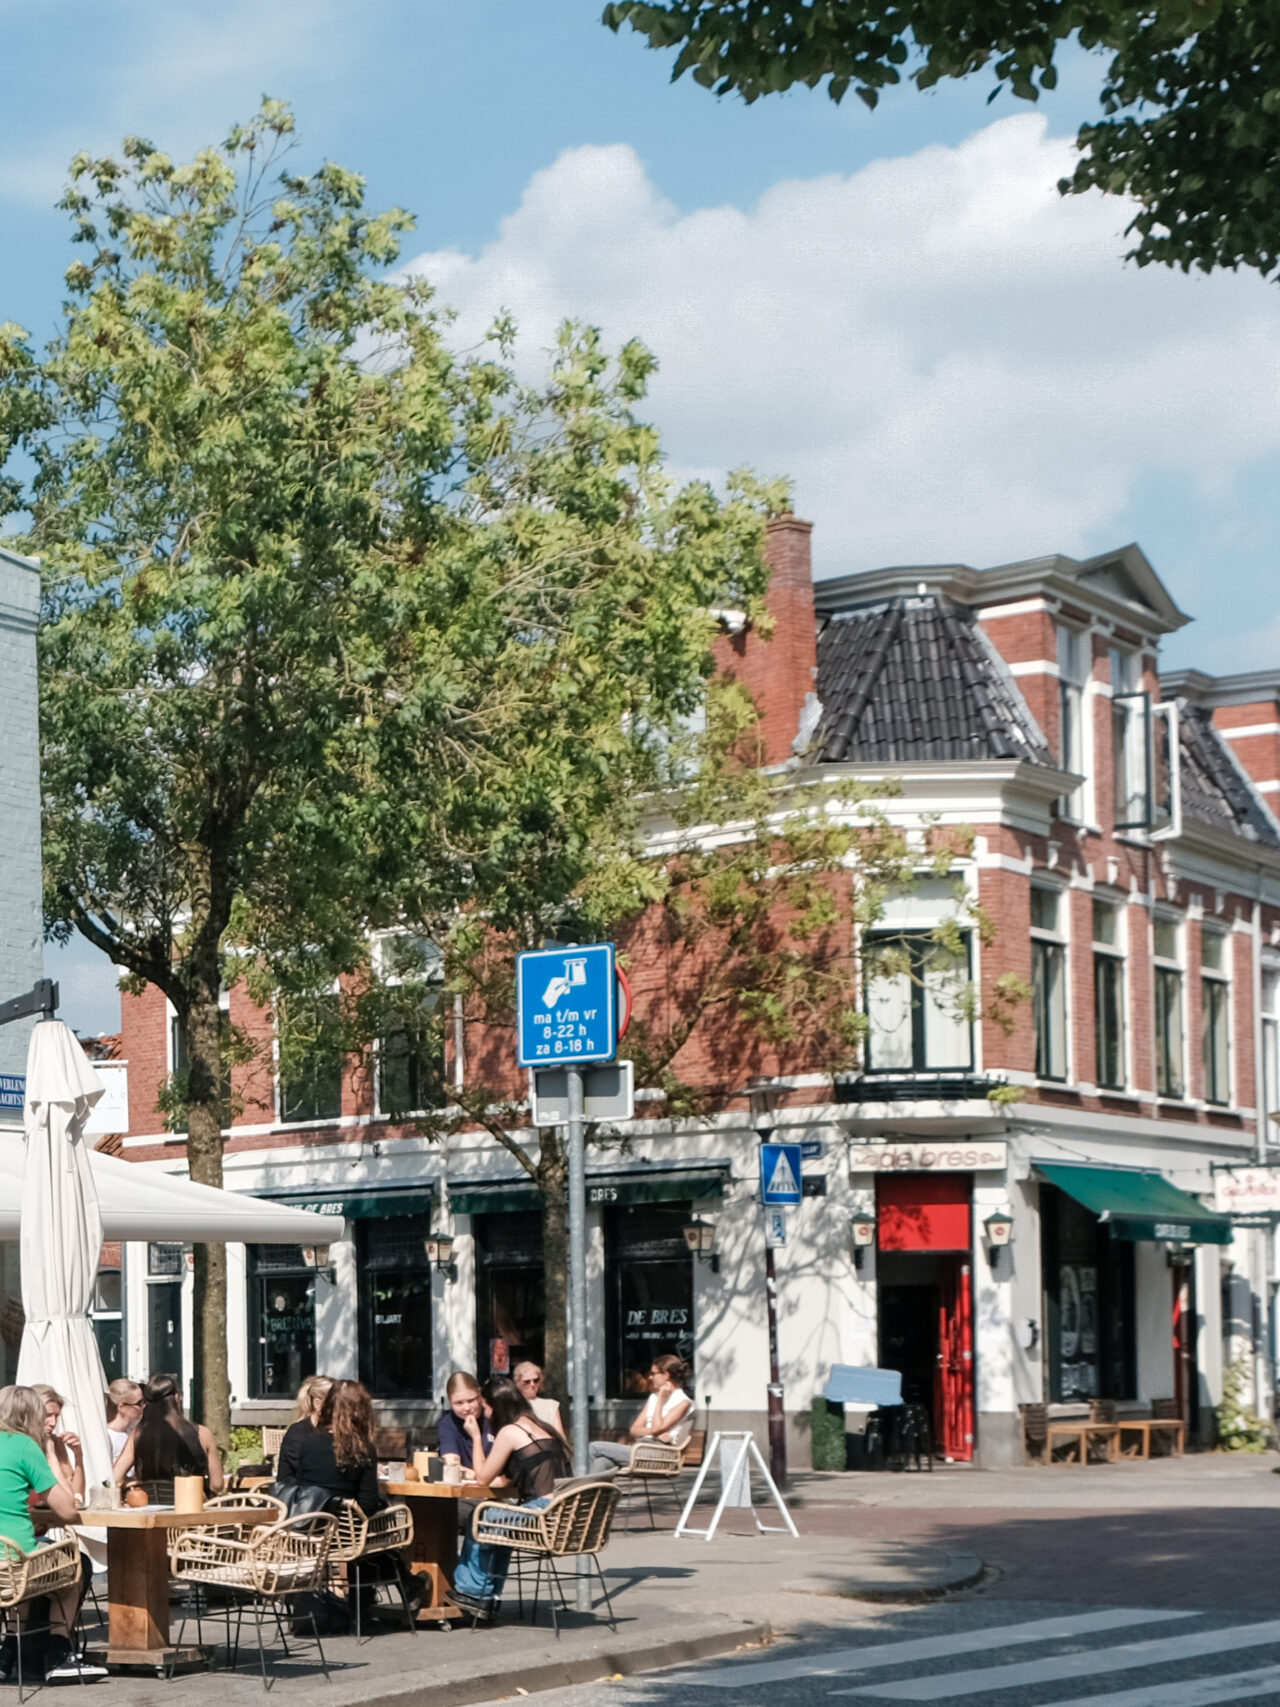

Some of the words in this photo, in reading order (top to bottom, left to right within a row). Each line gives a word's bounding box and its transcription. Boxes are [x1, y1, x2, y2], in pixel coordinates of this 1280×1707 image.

[534, 1013, 552, 1024] ma
[556, 1008, 579, 1023] t/m
[583, 1009, 597, 1020] vr
[543, 1024, 574, 1039] 8-22
[579, 1023, 587, 1036] h
[536, 1044, 550, 1056] za
[555, 1039, 582, 1054] 8-18
[586, 1038, 595, 1051] h
[919, 1147, 976, 1167] bres
[320, 1202, 344, 1214] BRES
[627, 1310, 646, 1325] DE
[651, 1308, 688, 1325] BRES
